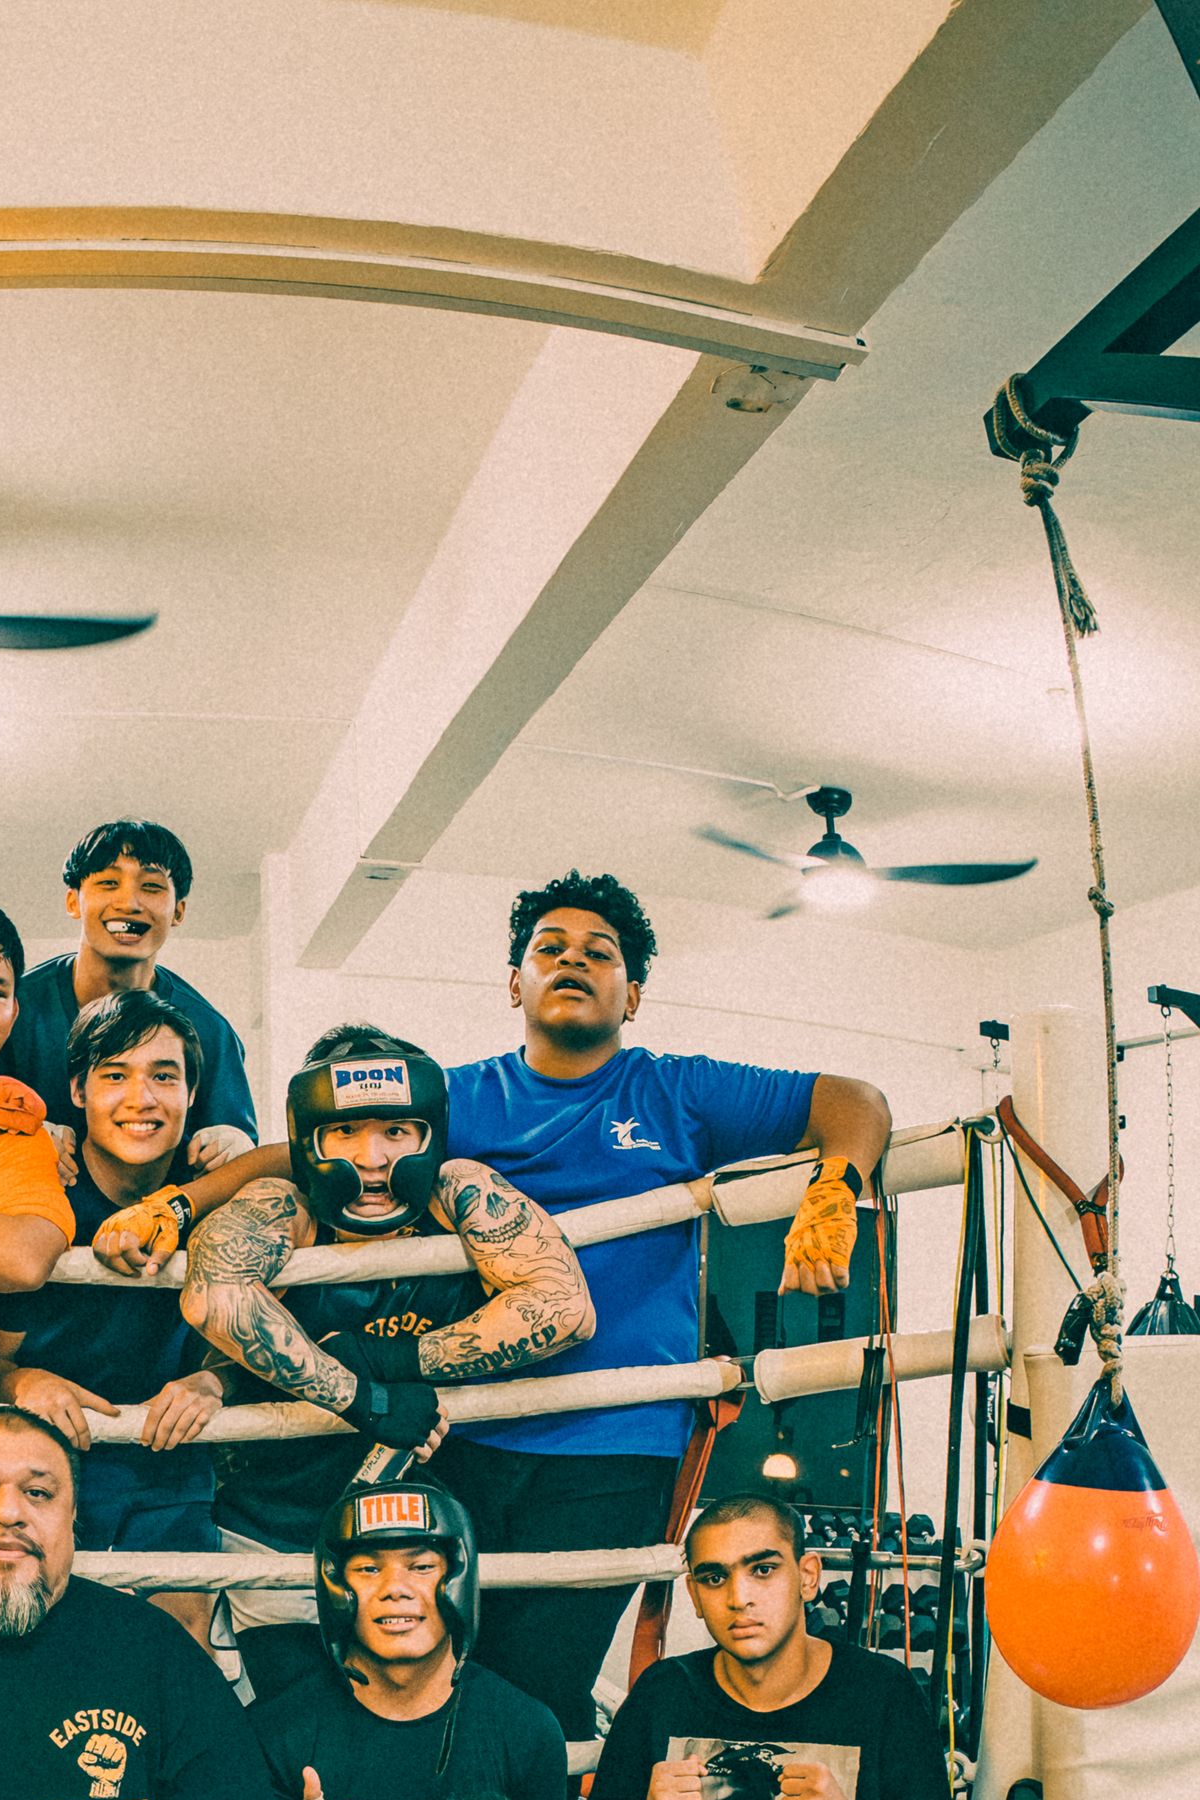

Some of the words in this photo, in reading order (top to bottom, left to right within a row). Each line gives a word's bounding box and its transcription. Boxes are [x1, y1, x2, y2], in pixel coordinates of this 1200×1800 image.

[335, 1066, 403, 1088] BOON
[363, 1495, 419, 1525] TITLE
[49, 1709, 147, 1749] EASTSIDE
